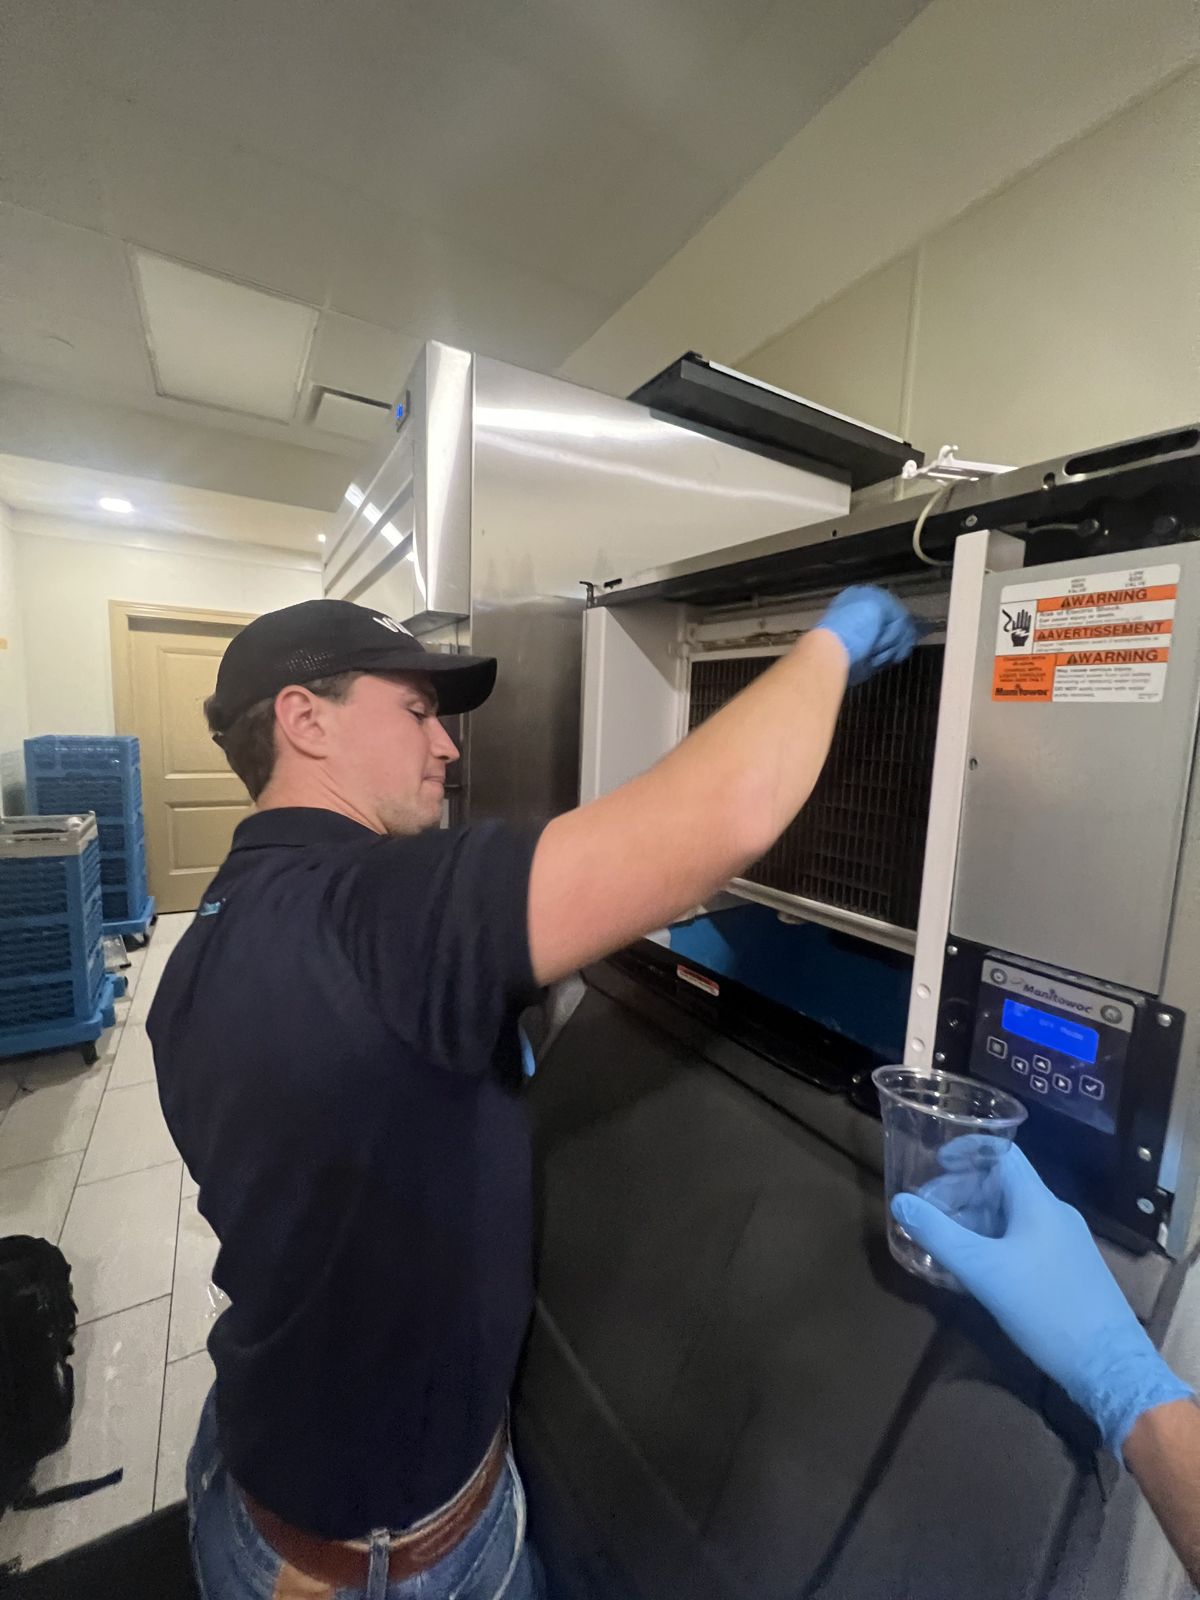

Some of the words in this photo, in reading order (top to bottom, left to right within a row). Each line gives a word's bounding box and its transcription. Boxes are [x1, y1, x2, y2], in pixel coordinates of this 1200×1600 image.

[1070, 588, 1147, 606] WARNING
[1047, 621, 1163, 640] AVERTISSEMENT
[1078, 649, 1158, 664] WARNING
[1023, 984, 1093, 1013] Manitowoc
